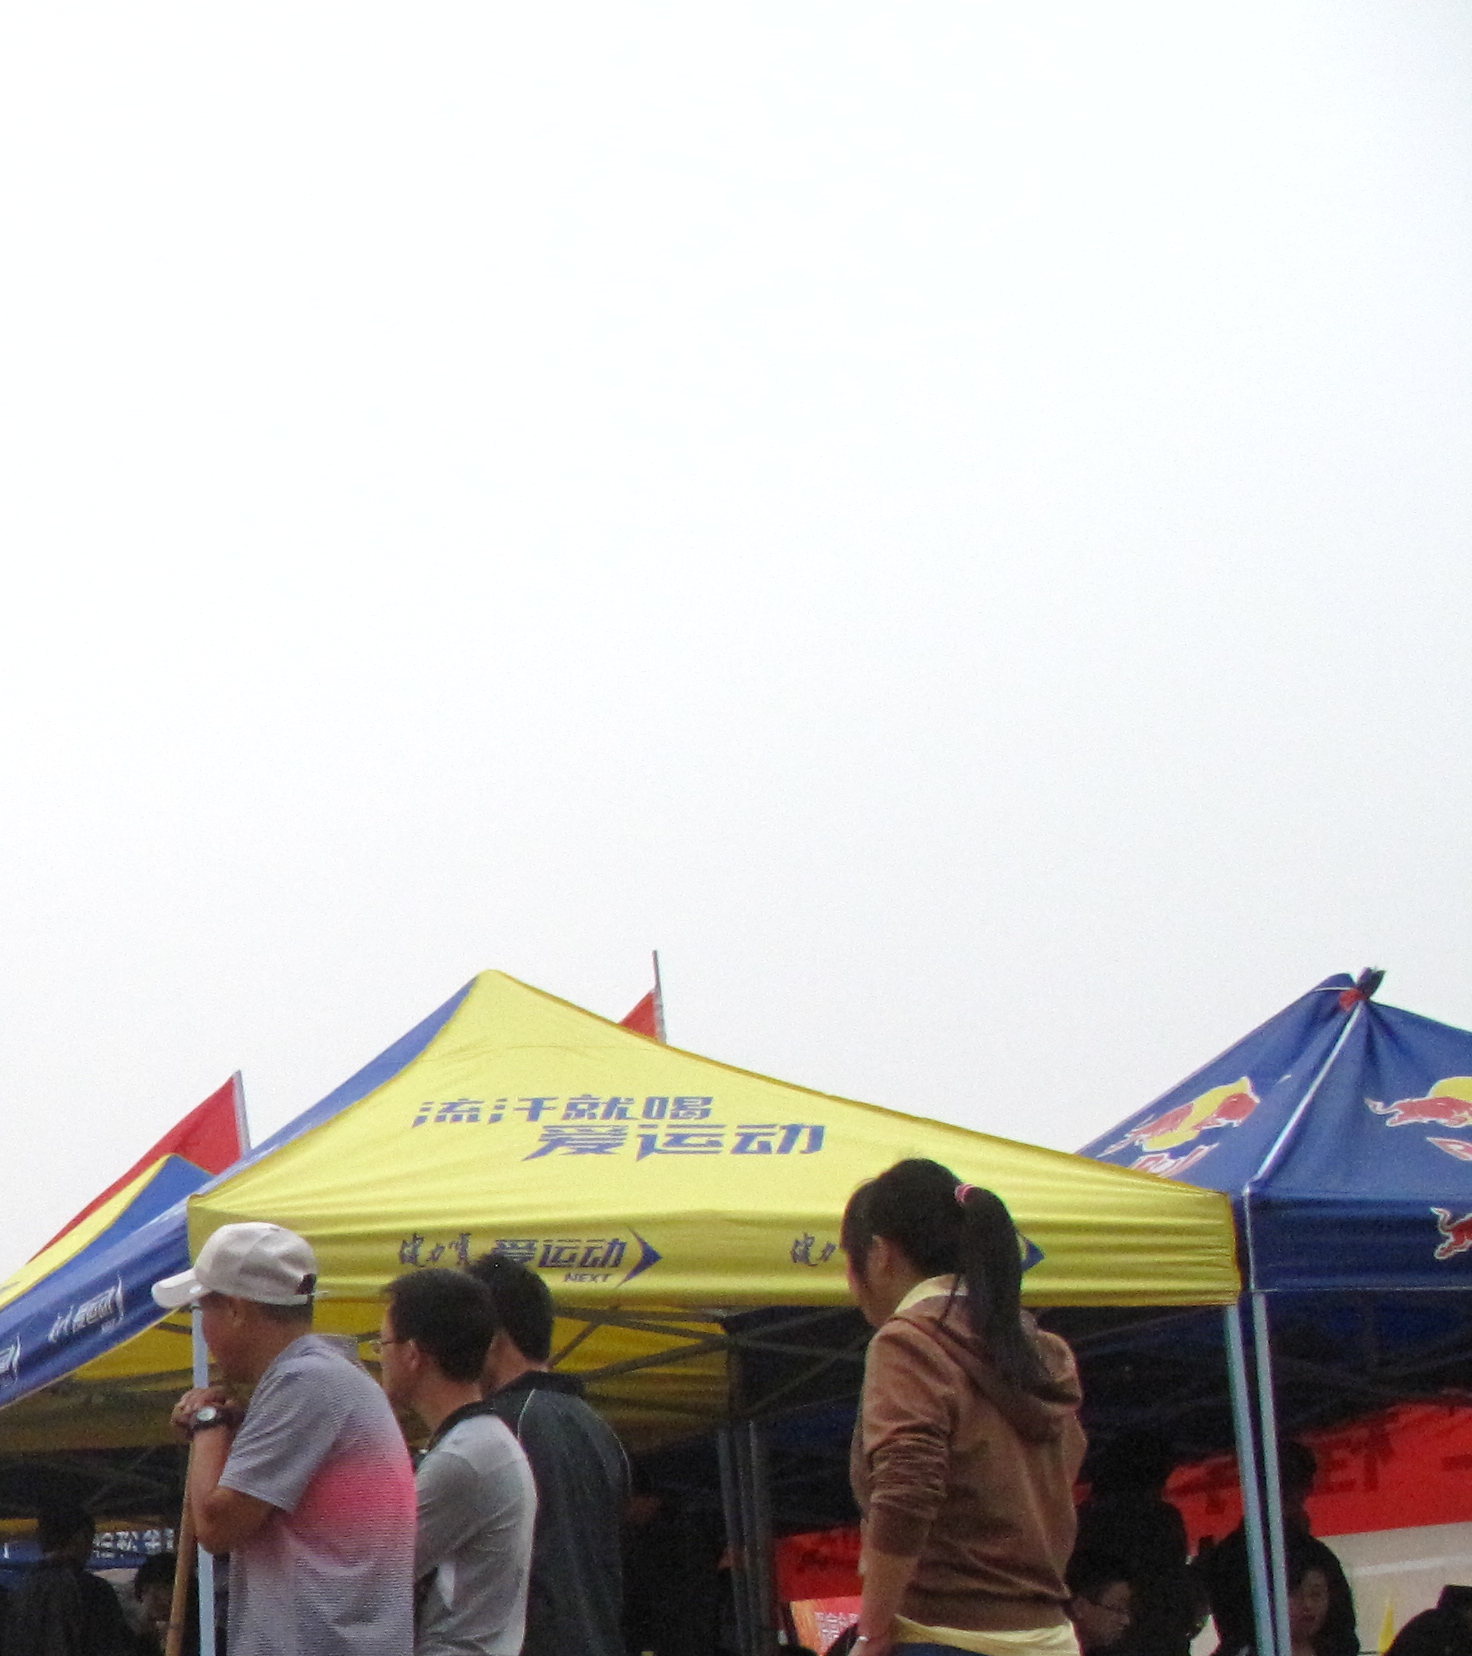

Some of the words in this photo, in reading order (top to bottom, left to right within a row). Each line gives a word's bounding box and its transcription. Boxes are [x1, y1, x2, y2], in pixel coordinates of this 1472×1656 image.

[411, 1094, 714, 1127] 流汗就喝
[522, 1123, 826, 1161] 爱运动
[492, 1237, 627, 1269] 爱运动
[563, 1272, 614, 1284] NEXT
